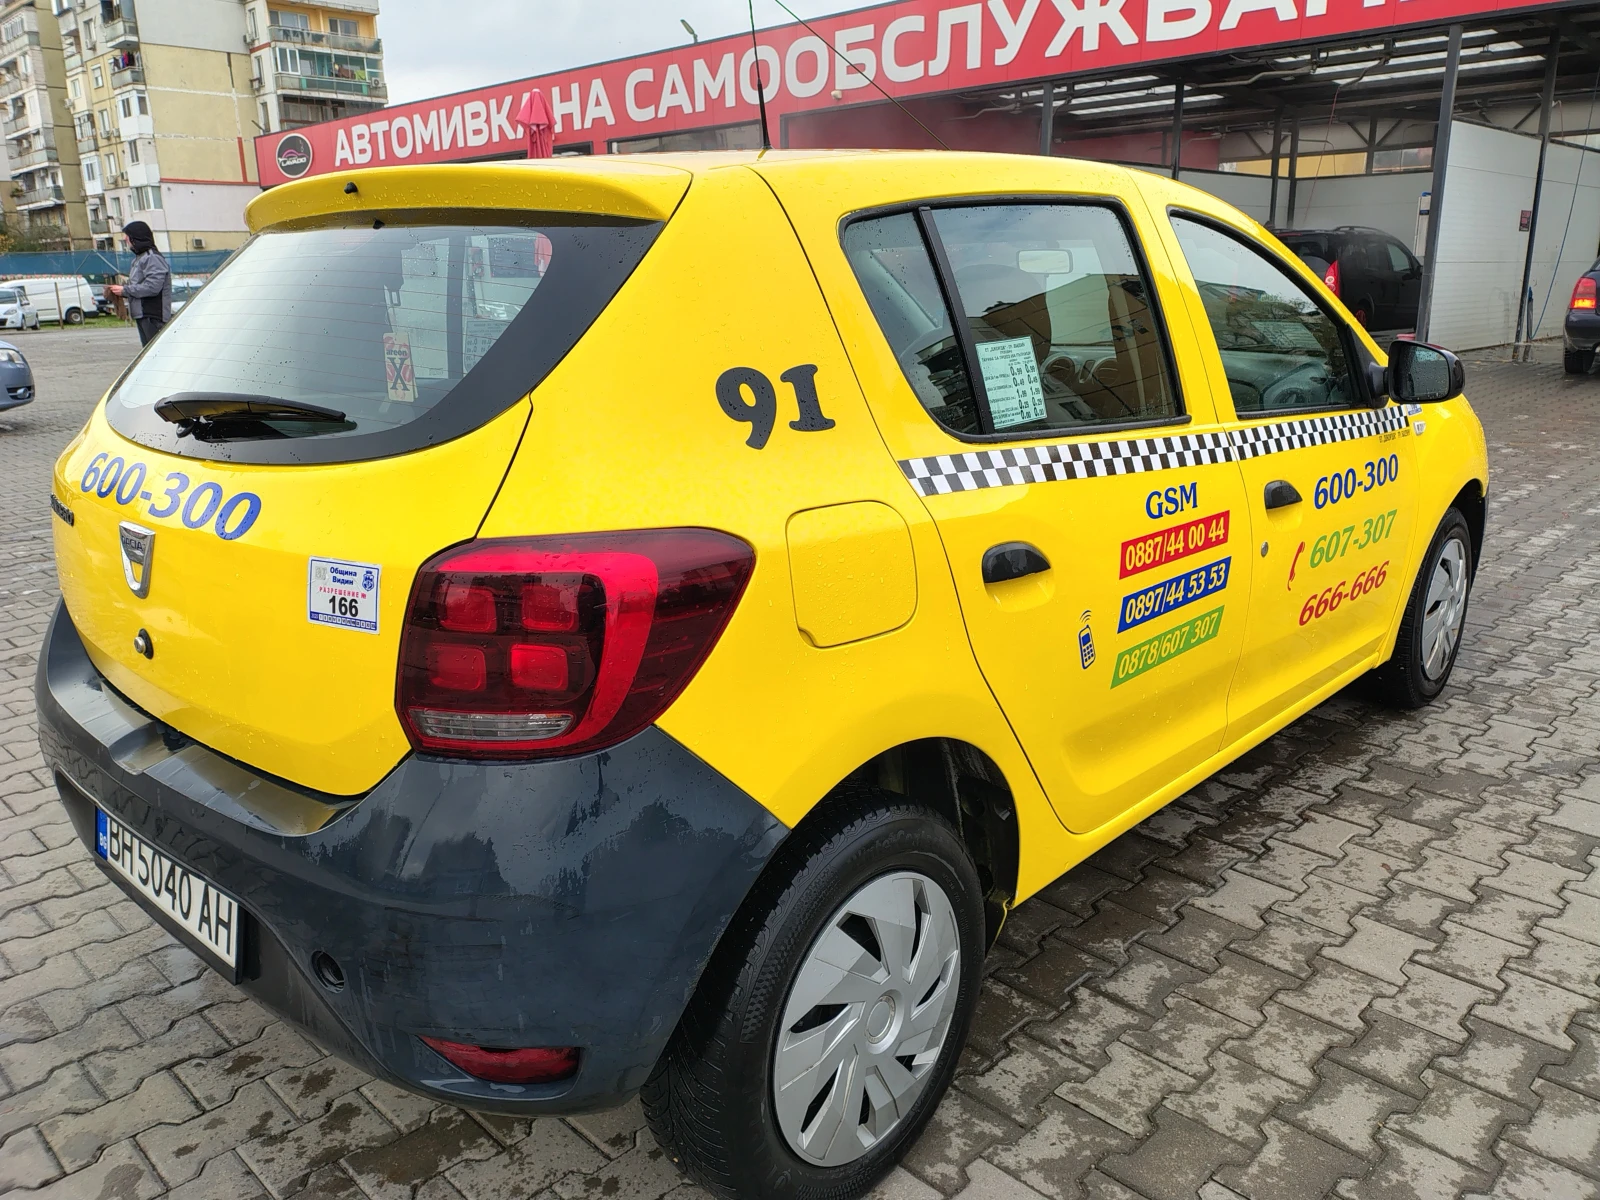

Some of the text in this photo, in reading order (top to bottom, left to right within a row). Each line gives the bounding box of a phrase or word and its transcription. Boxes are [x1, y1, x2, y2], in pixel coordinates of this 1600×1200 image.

[551, 78, 616, 133] НА
[625, 0, 1388, 123] САМООБСЛУЖВ
[386, 349, 408, 357] areon
[715, 364, 836, 450] 91
[80, 453, 262, 540] 600-300
[1145, 482, 1198, 519] GSM
[1314, 454, 1399, 510] 600-300
[1125, 517, 1225, 571] 0887/44 00 44
[1309, 509, 1398, 569] 607-307
[319, 586, 359, 598] РАЗРЕШЕНИЕ
[330, 566, 357, 576] Община
[332, 576, 353, 585] Видин
[1125, 563, 1226, 624] 0897/44 53 53
[1298, 560, 1390, 626] 666-666
[329, 595, 359, 617] 166
[1118, 612, 1219, 679] 0878/607 307
[99, 832, 108, 850] BG
[198, 881, 232, 956] AH
